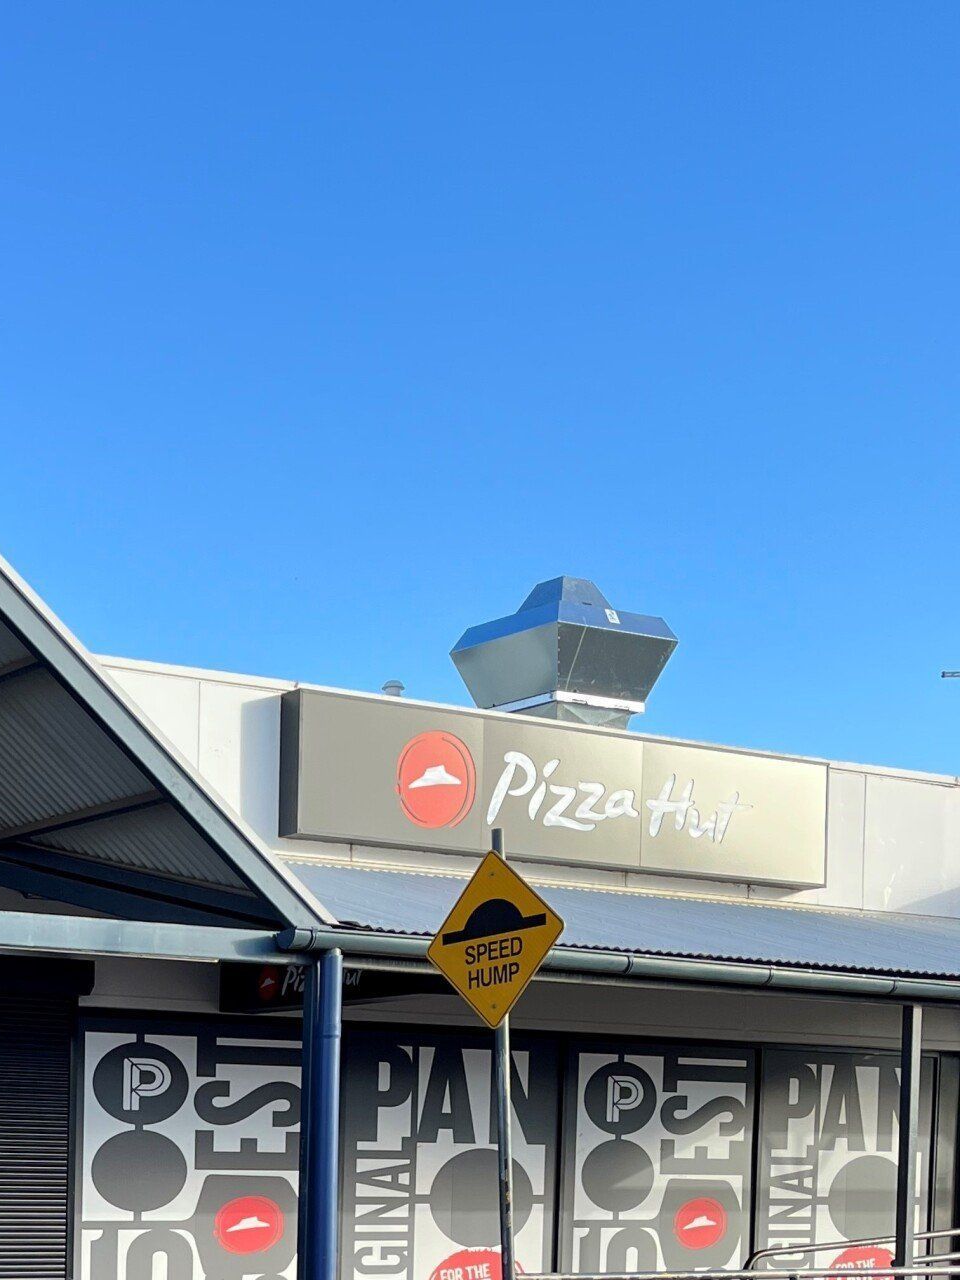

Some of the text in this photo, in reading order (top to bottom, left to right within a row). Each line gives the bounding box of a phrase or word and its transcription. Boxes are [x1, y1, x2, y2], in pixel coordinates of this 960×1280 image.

[486, 751, 753, 844] Pizza Hut
[465, 936, 523, 965] SPEED
[468, 962, 520, 989] HUMP
[356, 1044, 544, 1145] PAN
[465, 1263, 490, 1280] THE
